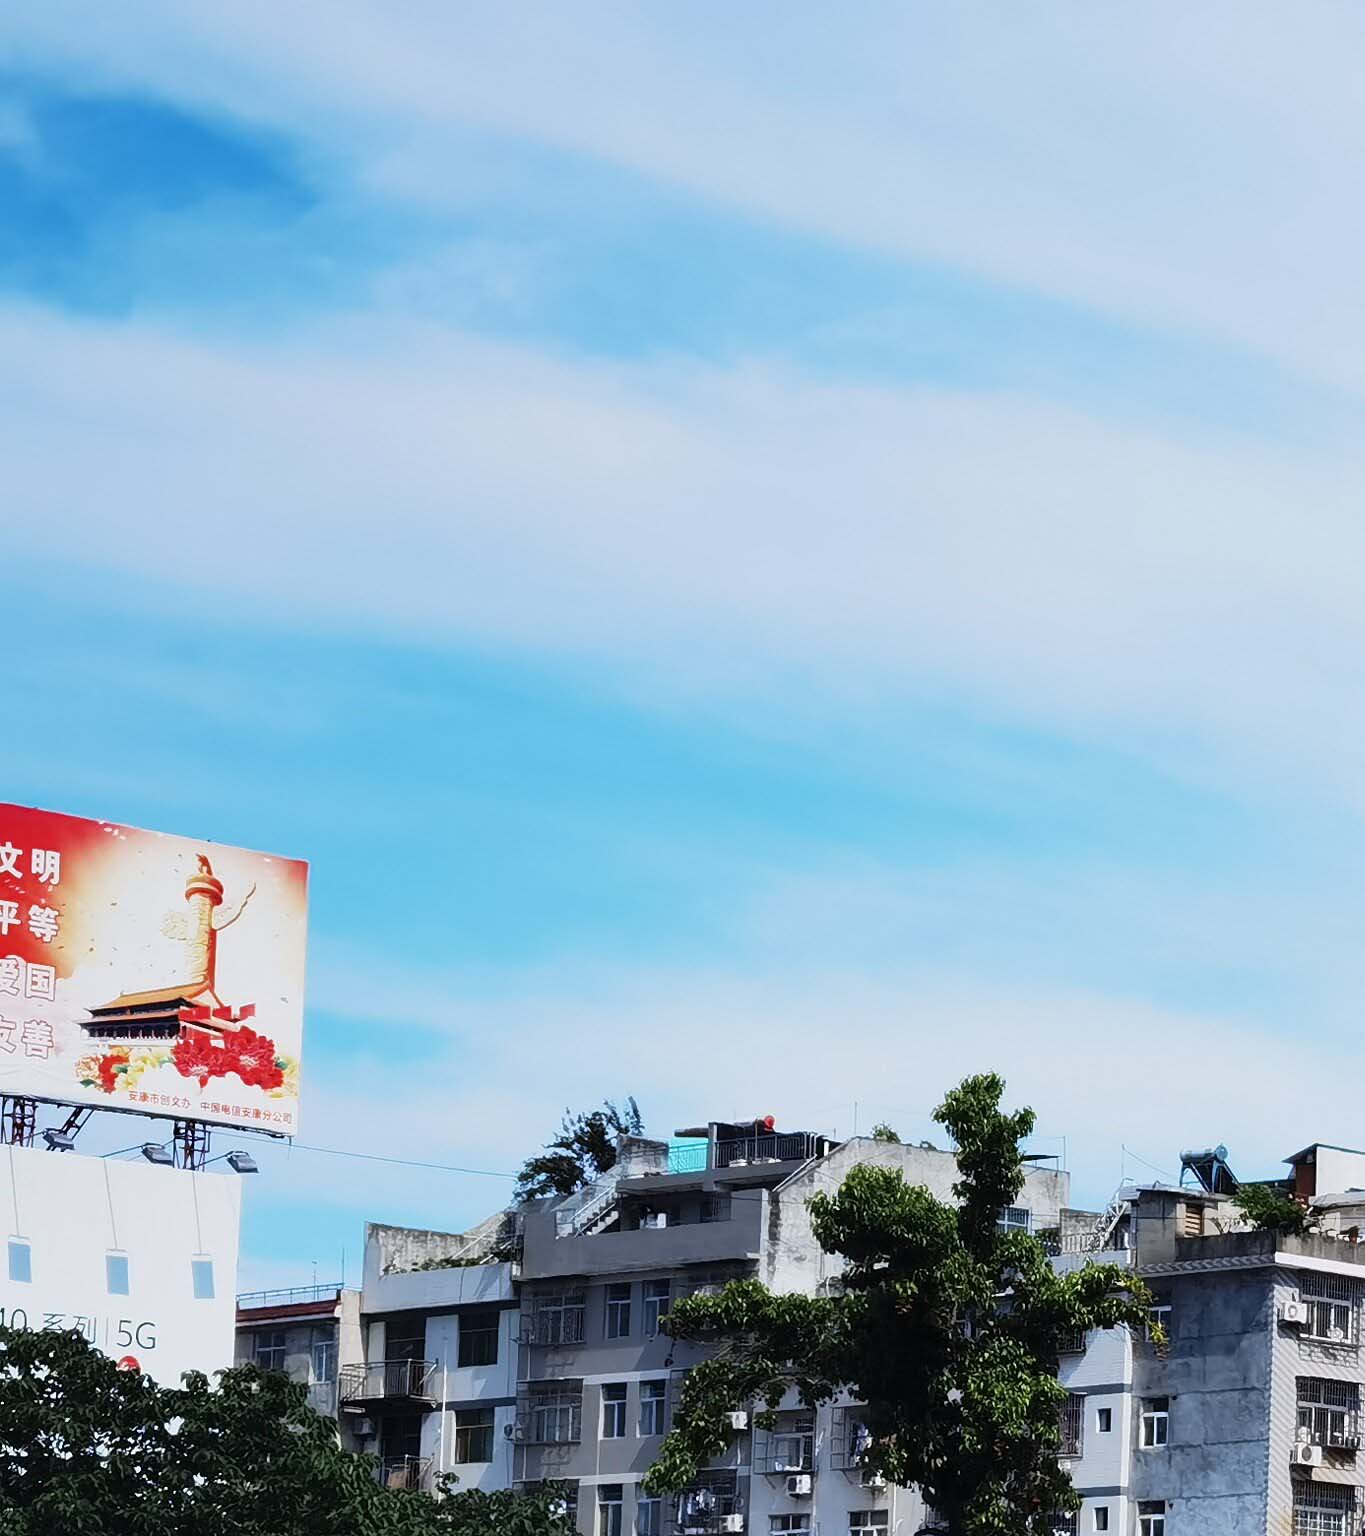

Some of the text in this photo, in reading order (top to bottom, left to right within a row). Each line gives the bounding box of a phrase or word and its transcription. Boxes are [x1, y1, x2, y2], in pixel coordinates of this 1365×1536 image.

[0, 841, 61, 886] 文明
[0, 899, 60, 943] 平等
[200, 1101, 292, 1125] 中国电信安康分公司
[117, 1319, 156, 1350] 5G
